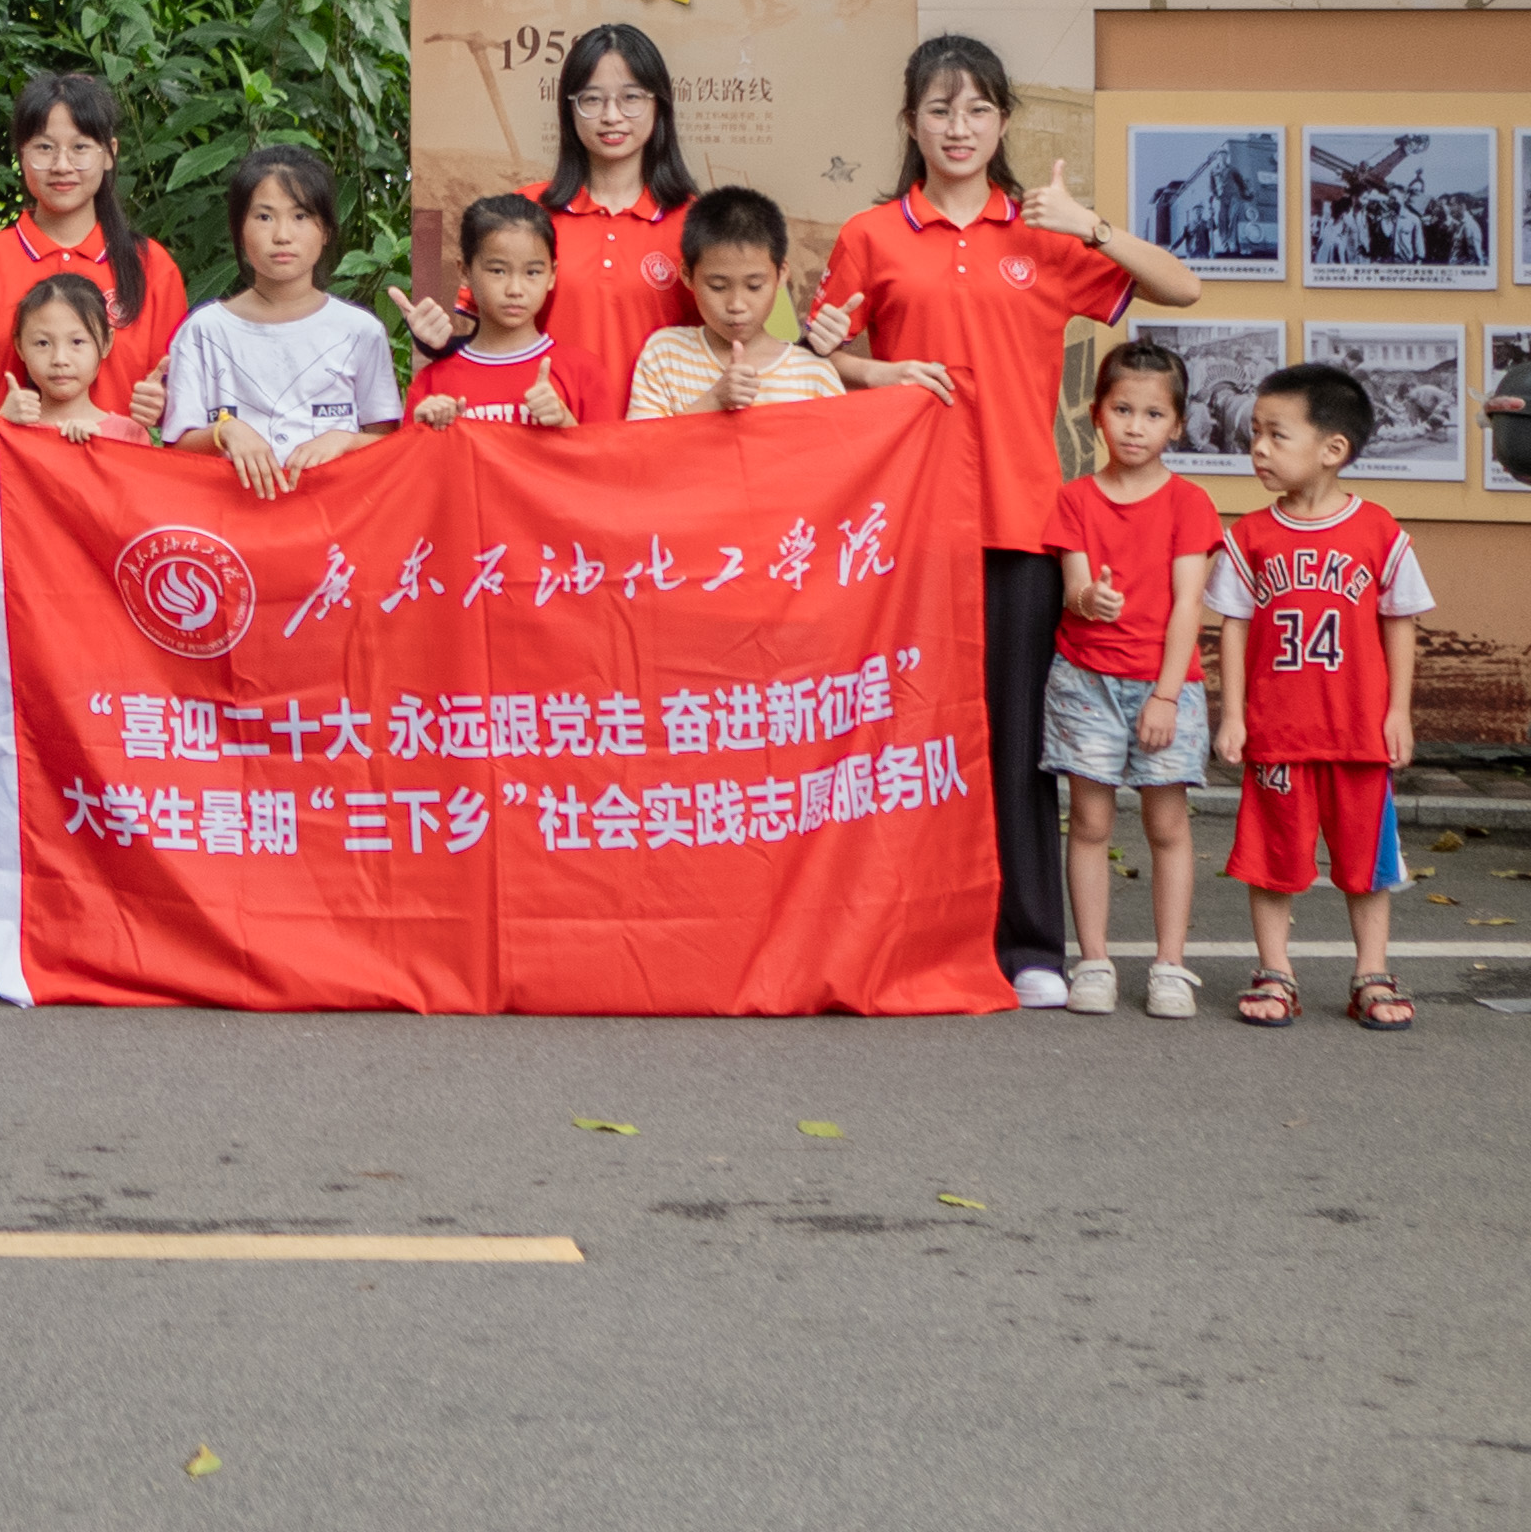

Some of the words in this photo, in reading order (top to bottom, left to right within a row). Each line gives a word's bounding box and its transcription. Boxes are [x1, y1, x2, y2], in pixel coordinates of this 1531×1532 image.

[499, 25, 580, 71] 195
[1272, 609, 1344, 671] 34
[387, 691, 648, 761] 永远跟党走
